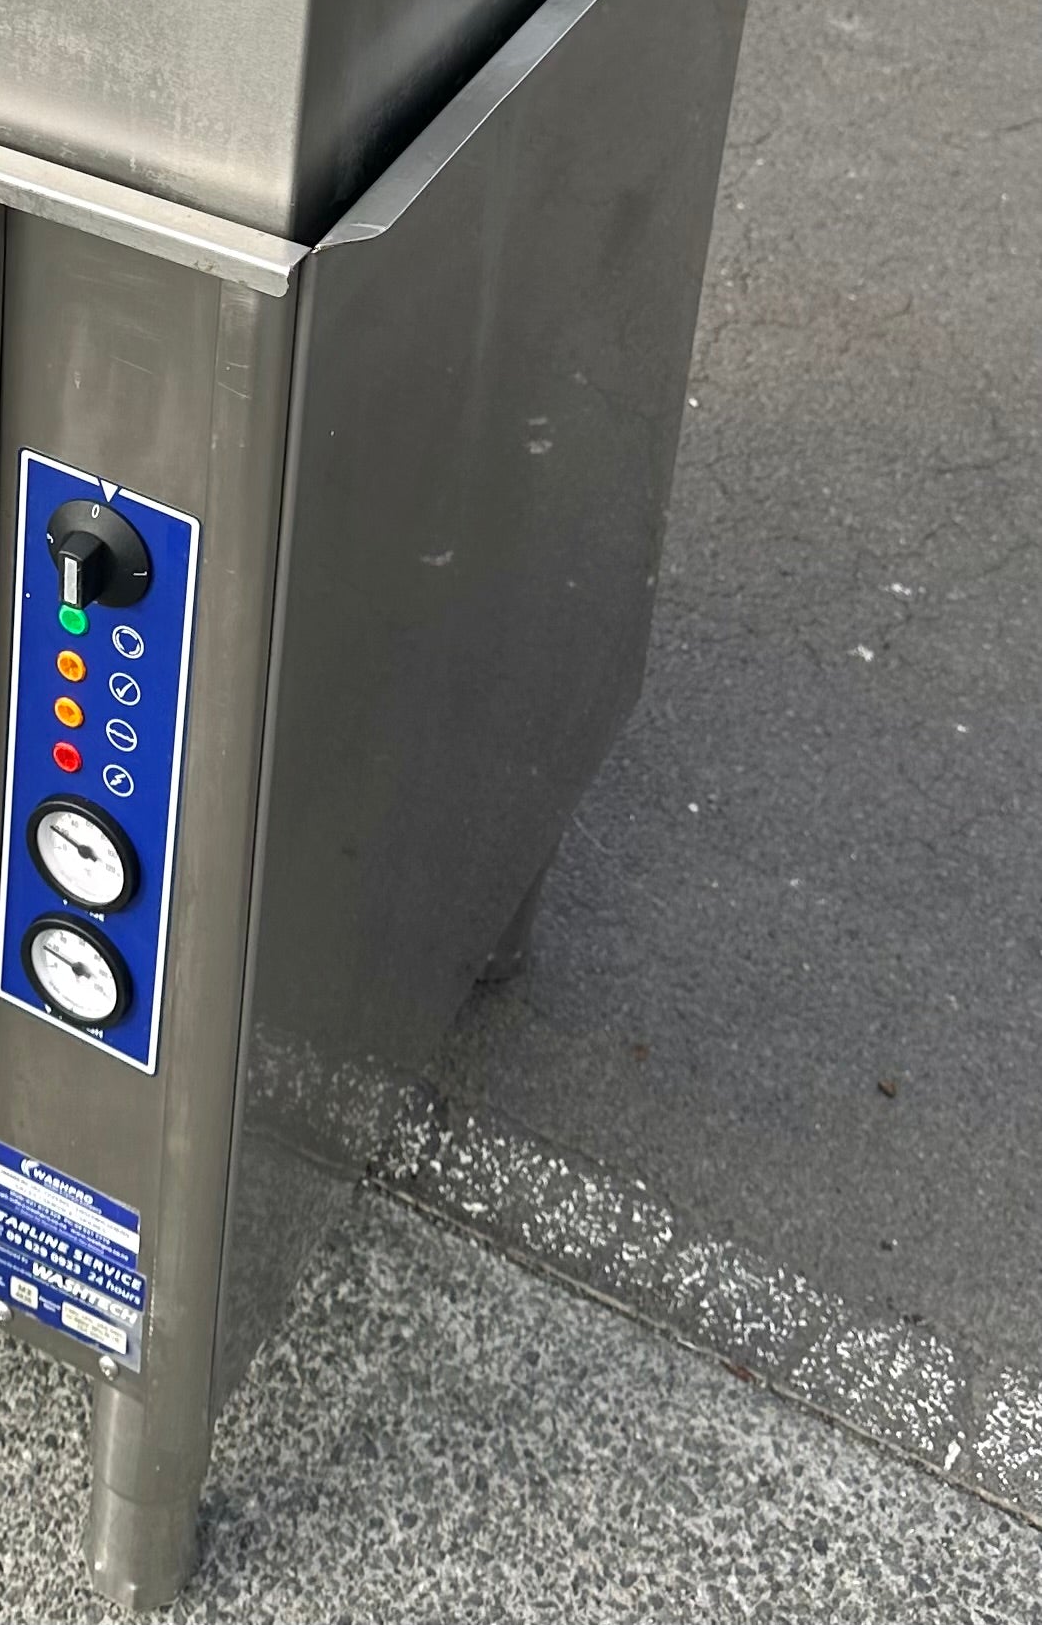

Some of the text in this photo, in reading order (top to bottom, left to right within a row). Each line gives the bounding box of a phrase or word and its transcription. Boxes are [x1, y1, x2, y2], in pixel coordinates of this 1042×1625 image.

[33, 1167, 94, 1206] WASHPRO
[73, 1249, 142, 1291] SERVICE
[87, 1271, 103, 1286] 24
[106, 1279, 141, 1305] hours
[32, 1262, 138, 1325] WASHTECH
